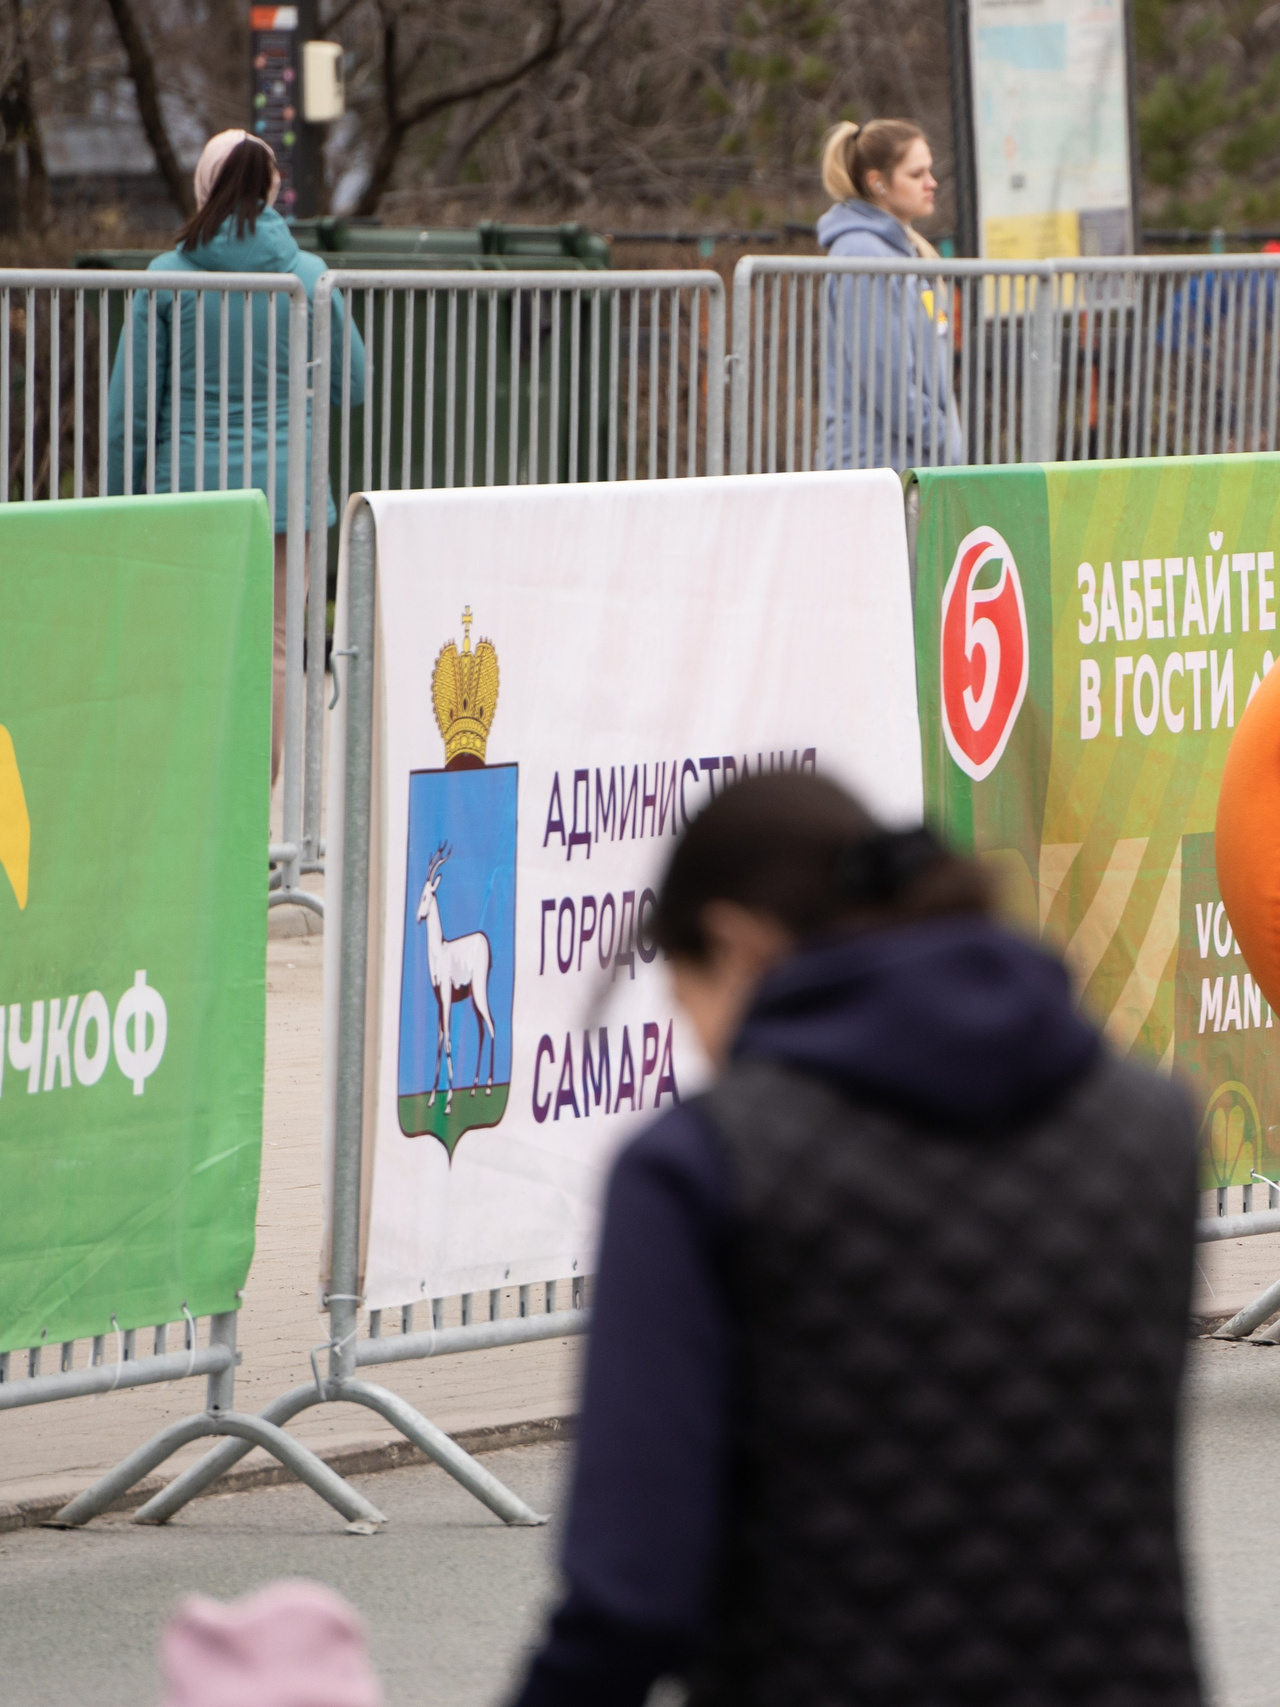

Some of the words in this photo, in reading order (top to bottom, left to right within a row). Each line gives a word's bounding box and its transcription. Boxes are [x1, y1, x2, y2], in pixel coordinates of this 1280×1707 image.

[1077, 530, 1276, 645] ЗАБЕГАЙТЕ
[1080, 659, 1102, 740] В
[1114, 648, 1235, 737] ГОСТИ
[532, 1018, 681, 1124] САМАРА
